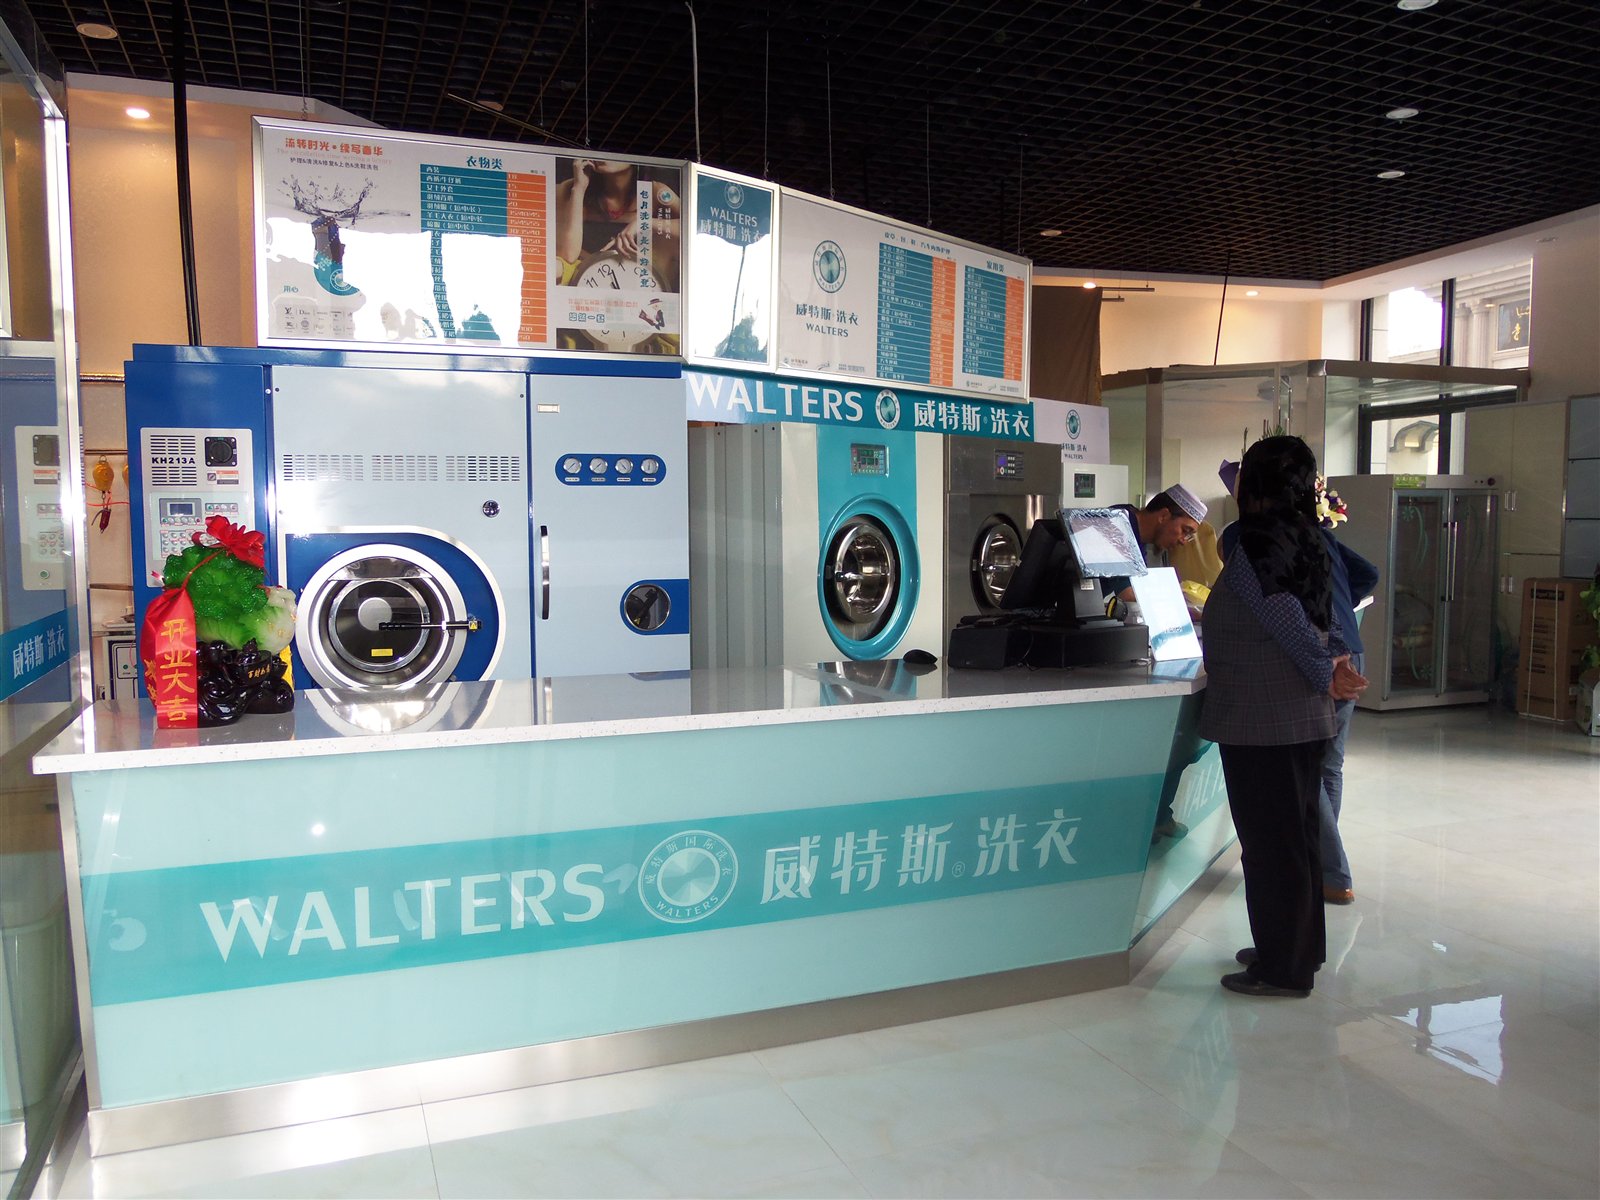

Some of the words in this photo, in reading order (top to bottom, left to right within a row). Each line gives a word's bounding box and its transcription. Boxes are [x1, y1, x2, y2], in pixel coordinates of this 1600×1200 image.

[467, 155, 503, 169] 衣物类
[710, 206, 758, 227] WALTERS
[805, 322, 849, 338] WALTERS
[687, 373, 863, 422] WALTERS
[151, 456, 196, 465] KH213A
[159, 618, 196, 722] 开业大吉
[199, 863, 605, 964] WALTERS
[655, 894, 720, 918] WALTERS
